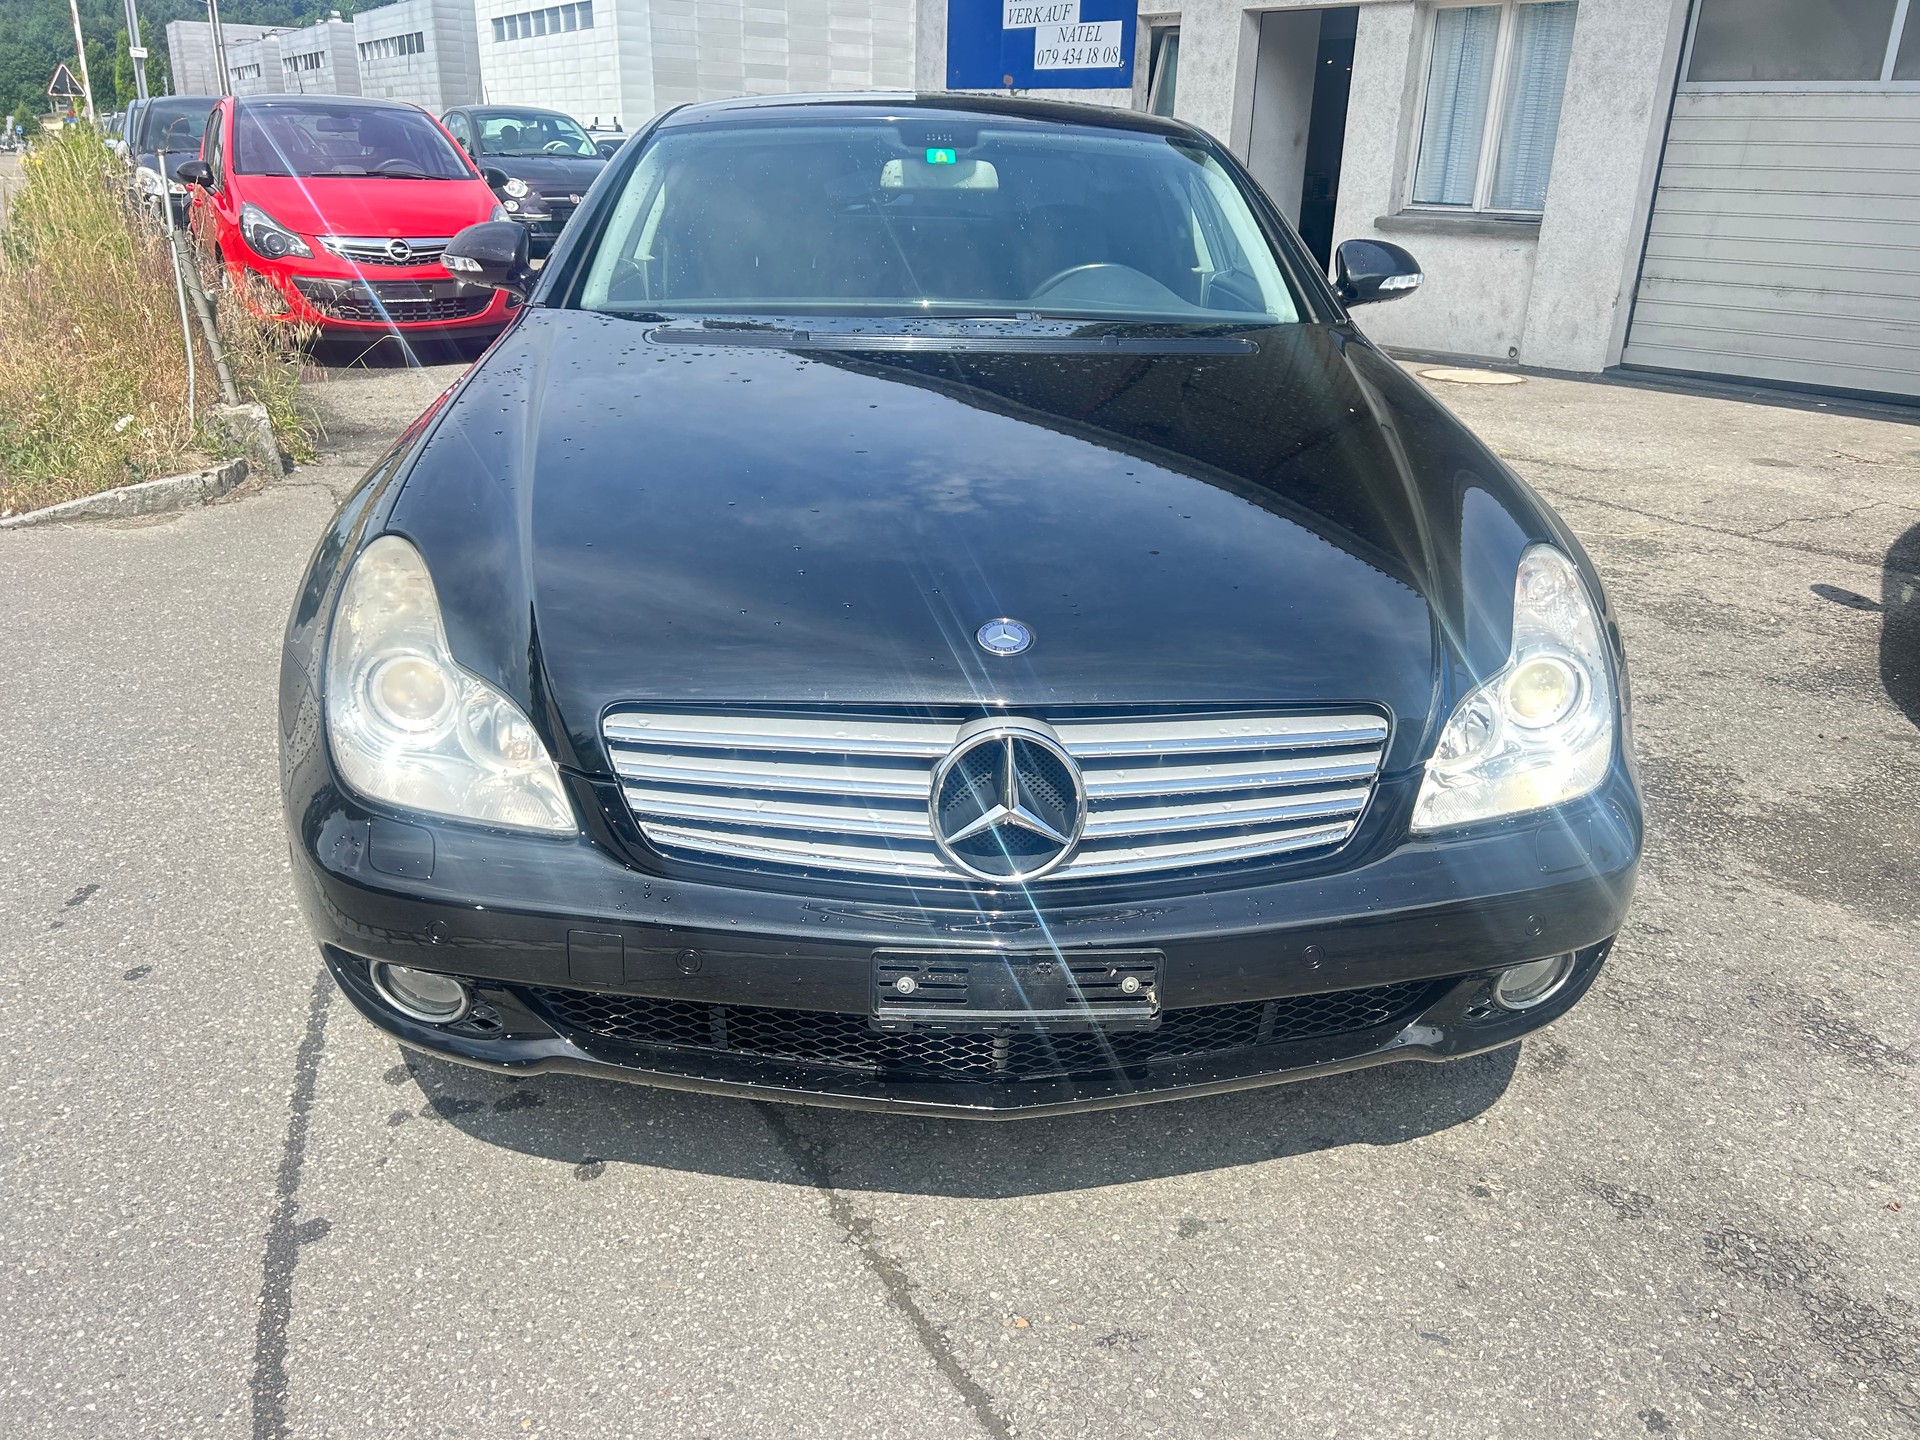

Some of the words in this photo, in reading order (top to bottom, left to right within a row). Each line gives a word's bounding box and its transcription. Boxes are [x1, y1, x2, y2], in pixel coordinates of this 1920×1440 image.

[1008, 4, 1073, 25] VERKAUF
[1057, 25, 1103, 43] NATEL
[1037, 48, 1059, 66] 079
[1062, 47, 1083, 65] 434
[1086, 46, 1099, 64] 18
[1103, 46, 1119, 63] 08
